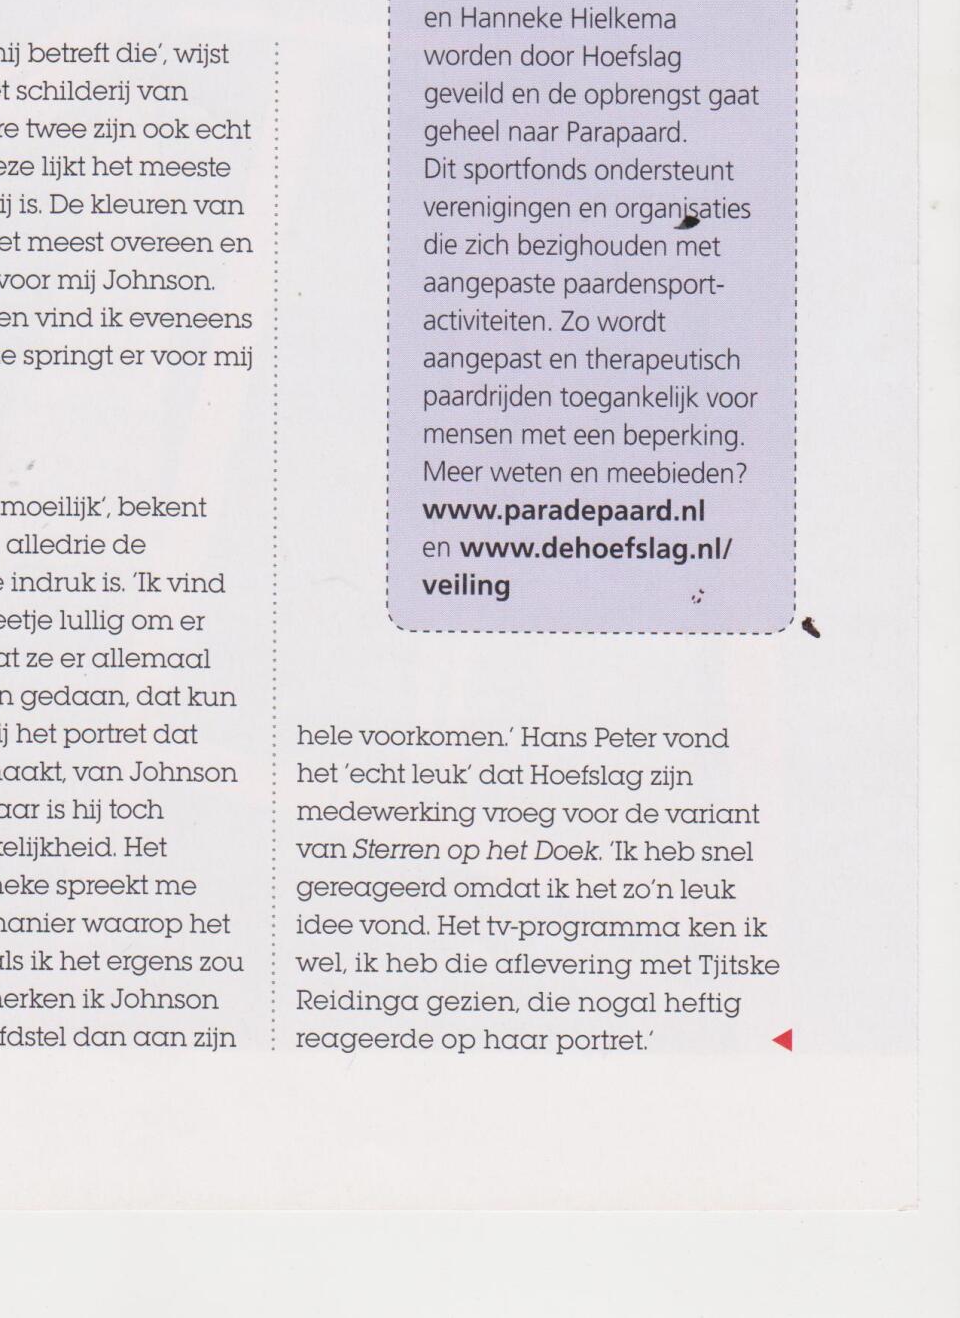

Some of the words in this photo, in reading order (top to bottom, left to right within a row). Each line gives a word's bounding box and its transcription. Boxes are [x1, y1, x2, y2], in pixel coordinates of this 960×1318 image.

[424, 11, 451, 28] en
[462, 6, 562, 28] Hanneke
[572, 6, 676, 29] Hielkema
[424, 43, 511, 66] worden
[521, 44, 574, 66] door
[583, 44, 681, 73] Hoefslag
[16, 80, 130, 105] schilderij
[137, 85, 188, 101] van
[425, 81, 503, 109] geveild
[512, 88, 539, 104] en
[549, 82, 576, 104] de
[585, 82, 701, 110] opbrengst
[709, 86, 759, 111] gaat
[425, 119, 499, 147] geheel
[509, 126, 559, 142] naar
[568, 120, 686, 148] Parapaard.
[425, 157, 456, 179] Dit
[464, 157, 586, 185] sportfonds
[595, 158, 734, 181] ondersteunt
[424, 195, 570, 223] verenigingen
[579, 202, 606, 218] en
[616, 197, 751, 217] organisaties
[27, 231, 104, 252] meest
[111, 236, 214, 252] overeen
[220, 237, 253, 253] en
[424, 232, 457, 255] die
[465, 233, 508, 255] zich
[518, 233, 666, 261] bezighouden
[677, 237, 720, 256] met
[424, 274, 555, 298] aangepaste
[564, 271, 724, 300] paardensport-
[34, 307, 93, 327] vind
[101, 307, 123, 327] ik
[129, 312, 252, 329] eveneens
[424, 309, 551, 331] activiteiten.
[561, 310, 589, 332] Zo
[597, 310, 666, 332] wordt
[424, 350, 542, 374] aangepast
[550, 353, 576, 369] en
[585, 347, 740, 375] therapeutisch
[424, 384, 551, 412] paardrijden
[560, 385, 699, 413] toegankelijk
[707, 392, 758, 408] voor
[424, 428, 512, 444] mensen
[522, 426, 566, 445] met
[574, 429, 614, 445] een
[624, 423, 744, 452] beperking.
[424, 460, 483, 482] Meer
[490, 463, 561, 482] weten
[571, 467, 597, 483] en
[608, 461, 747, 483] meebieden?
[422, 498, 704, 526] www.paradepaard.nl
[423, 541, 450, 557] en
[460, 536, 733, 565] www.dehoefslag.nl/
[422, 573, 510, 602] veiling
[72, 766, 124, 781] van
[130, 761, 238, 782] Johnson
[297, 801, 476, 827] medewerking
[482, 807, 556, 828] vroeg
[562, 808, 619, 823] voor
[625, 803, 659, 823] de
[665, 804, 760, 824] variant
[56, 874, 149, 900] spreekt
[155, 879, 197, 895] me
[296, 990, 419, 1016] Reidinga
[427, 991, 519, 1016] gezien,
[528, 992, 570, 1012] die
[578, 992, 656, 1018] nogal
[664, 992, 742, 1018] heftig
